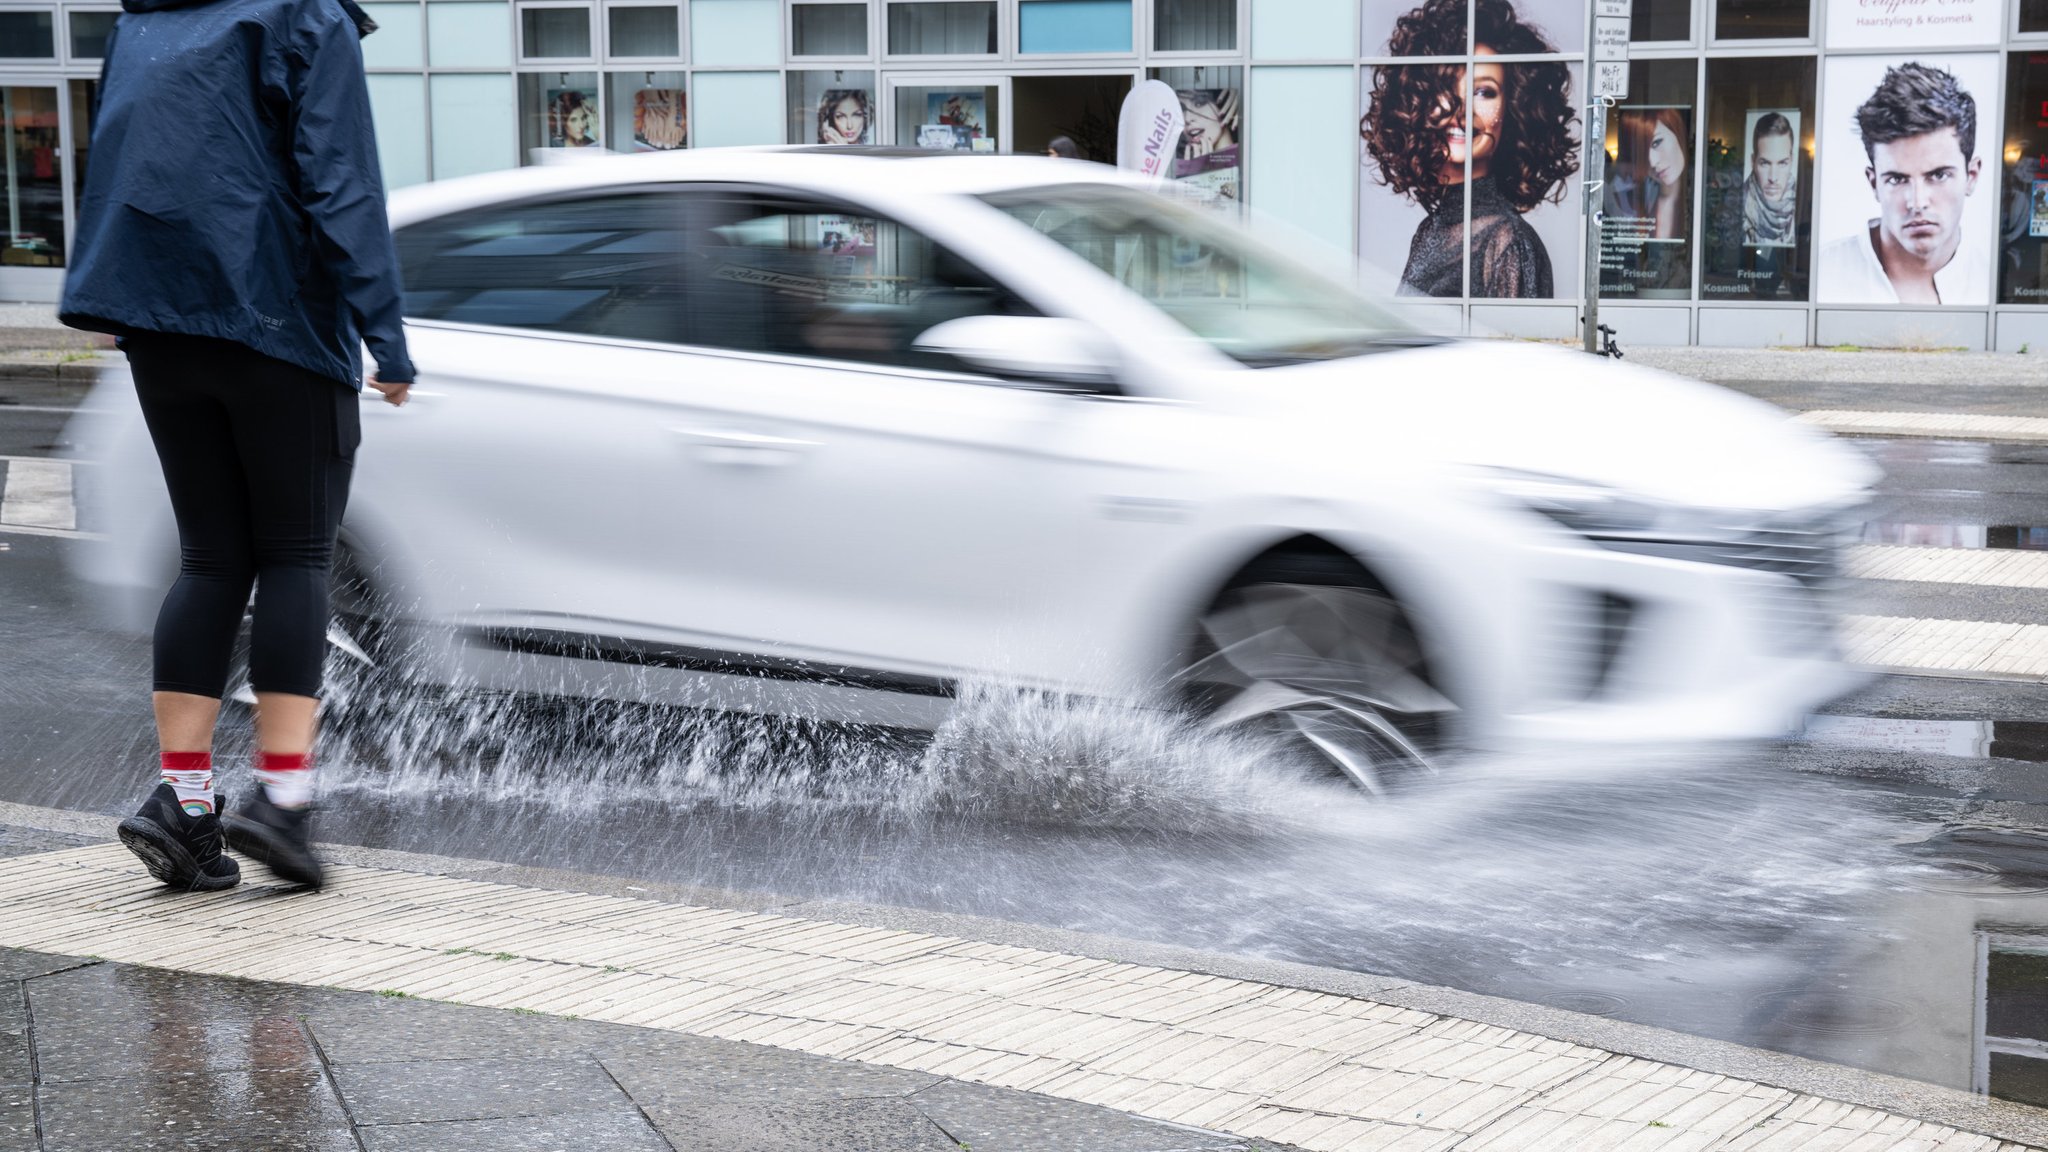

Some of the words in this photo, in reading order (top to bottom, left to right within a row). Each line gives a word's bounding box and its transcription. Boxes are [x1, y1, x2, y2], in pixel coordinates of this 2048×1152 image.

[1856, 17, 1912, 27] Haarstyling
[1916, 15, 1924, 25] &
[1927, 14, 1974, 25] Kosmetik
[1623, 269, 1658, 278] Friseur
[1737, 269, 1774, 279] Friseur
[1599, 283, 1635, 292] osmetik
[1703, 283, 1750, 293] Kosmetik
[2014, 286, 2048, 296] Kosme
